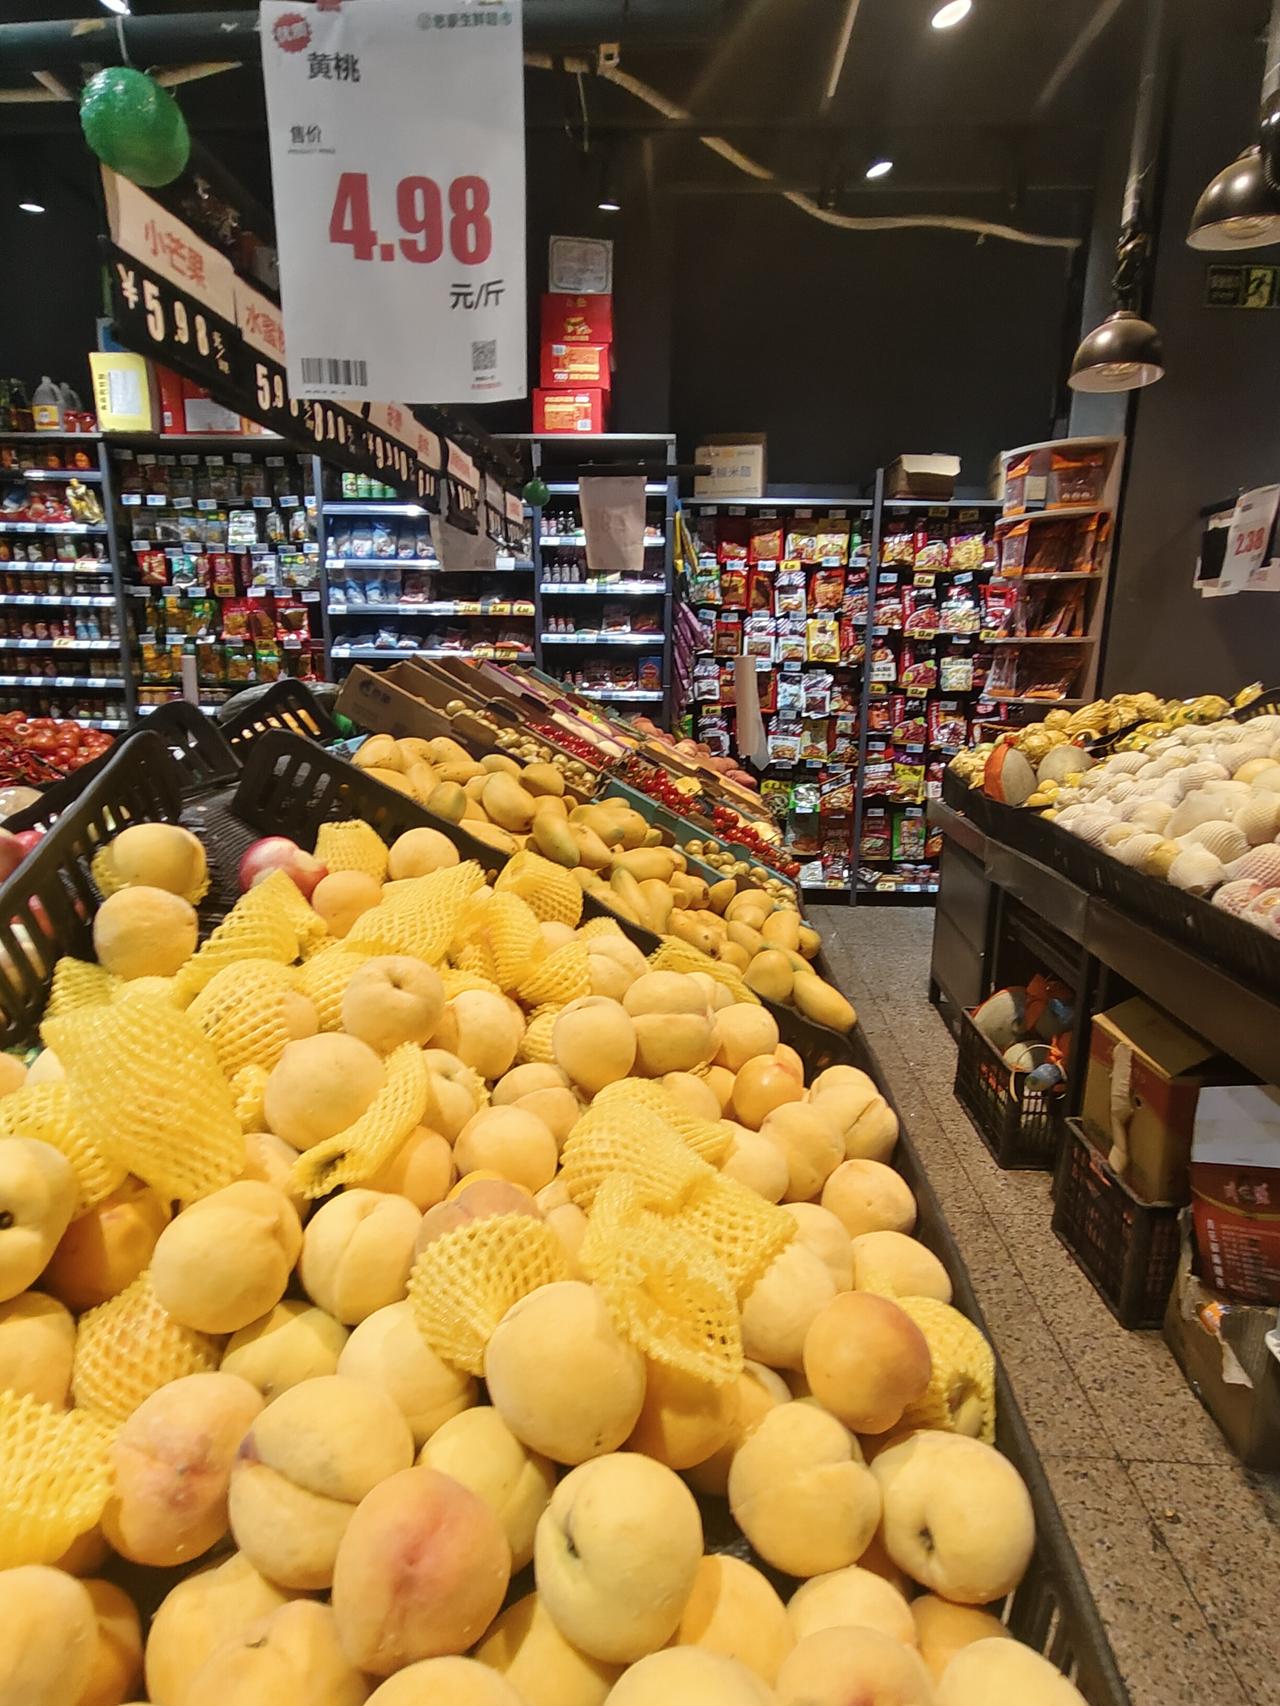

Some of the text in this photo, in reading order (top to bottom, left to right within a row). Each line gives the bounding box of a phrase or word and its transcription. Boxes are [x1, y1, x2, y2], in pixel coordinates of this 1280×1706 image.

[307, 52, 361, 83] 黄桃
[290, 124, 322, 144] 售价
[328, 172, 493, 265] 4.98
[144, 219, 207, 289] 小芒果
[449, 279, 505, 311] 元/斤
